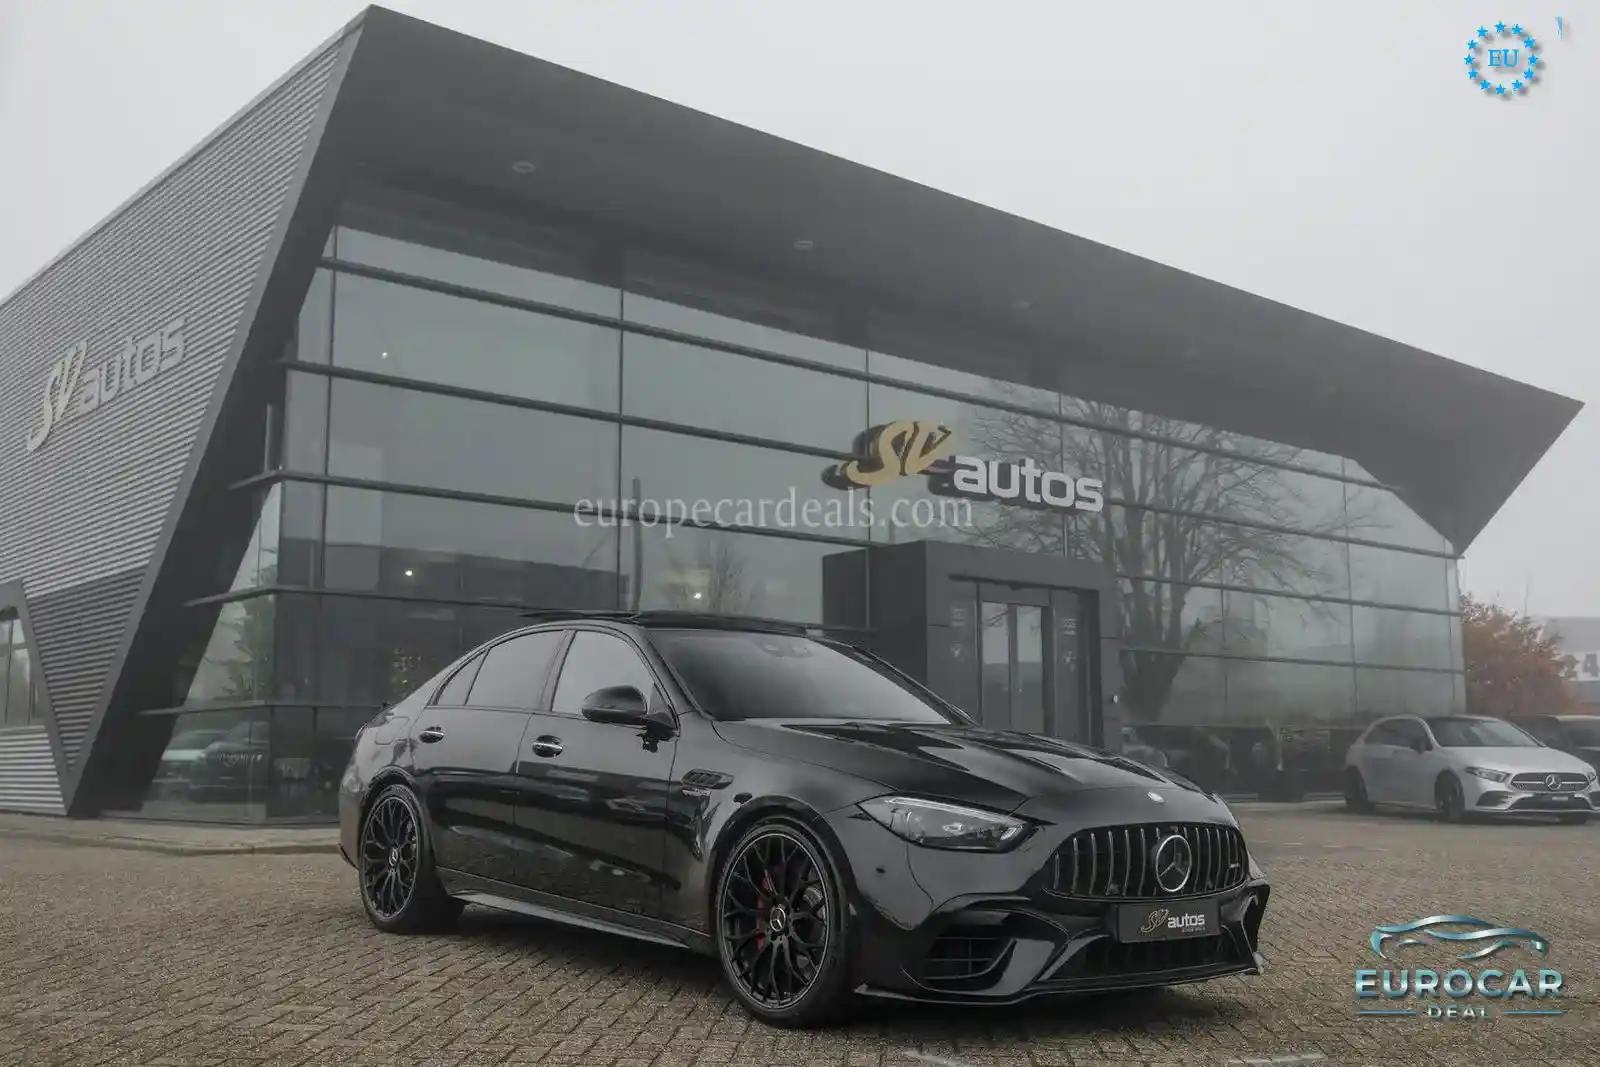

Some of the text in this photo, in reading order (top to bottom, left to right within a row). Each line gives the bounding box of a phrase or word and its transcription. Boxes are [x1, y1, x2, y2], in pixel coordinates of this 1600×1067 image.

[78, 317, 188, 414] autos
[953, 455, 1105, 513] autos
[1167, 913, 1205, 929] autos
